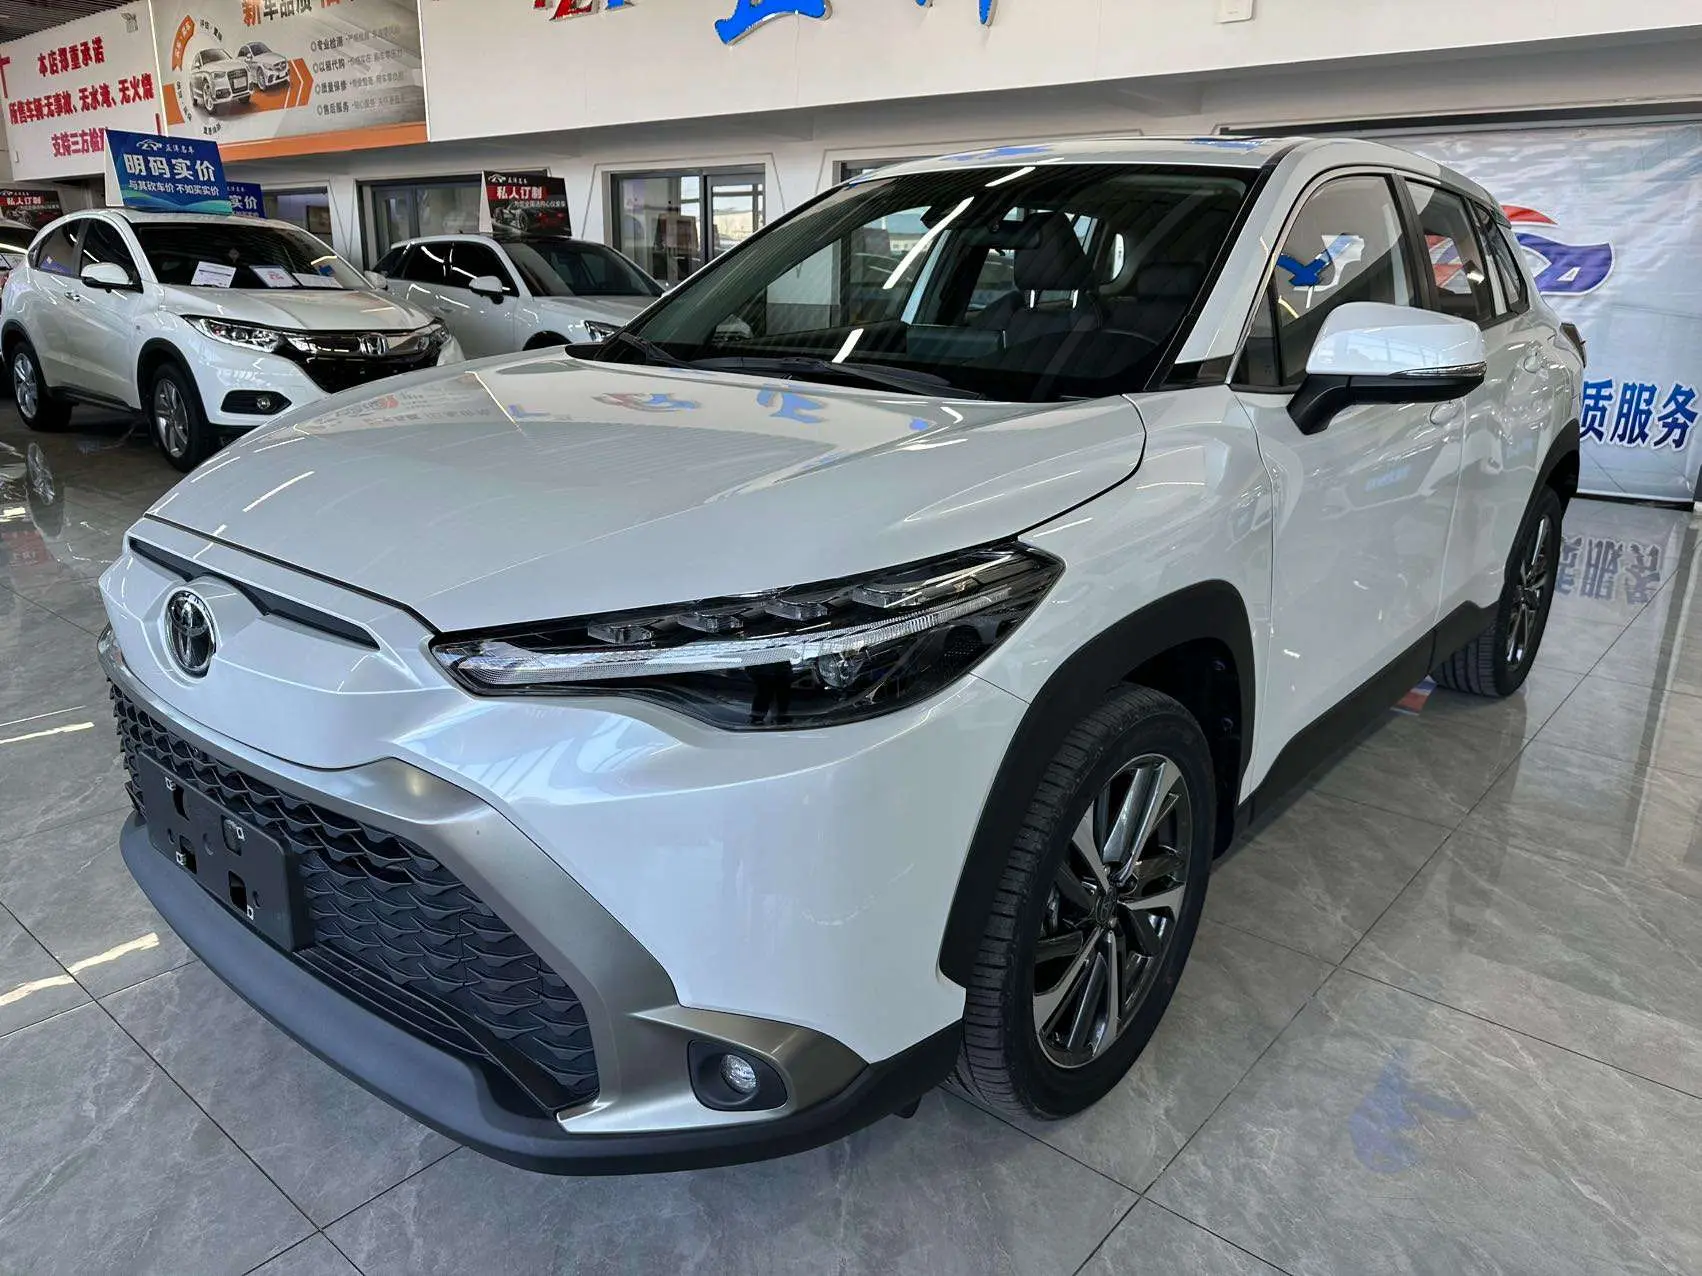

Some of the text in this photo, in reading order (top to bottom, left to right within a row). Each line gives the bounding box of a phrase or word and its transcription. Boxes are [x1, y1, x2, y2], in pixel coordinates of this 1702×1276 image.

[37, 36, 105, 77] 本店郑重承诺
[123, 153, 216, 182] 明码实价
[128, 180, 175, 194] 与其砍车价
[176, 183, 220, 197] 不如买实价
[496, 185, 543, 200] 私人订制
[228, 194, 258, 210] 实价
[1580, 378, 1699, 449] 质服务
